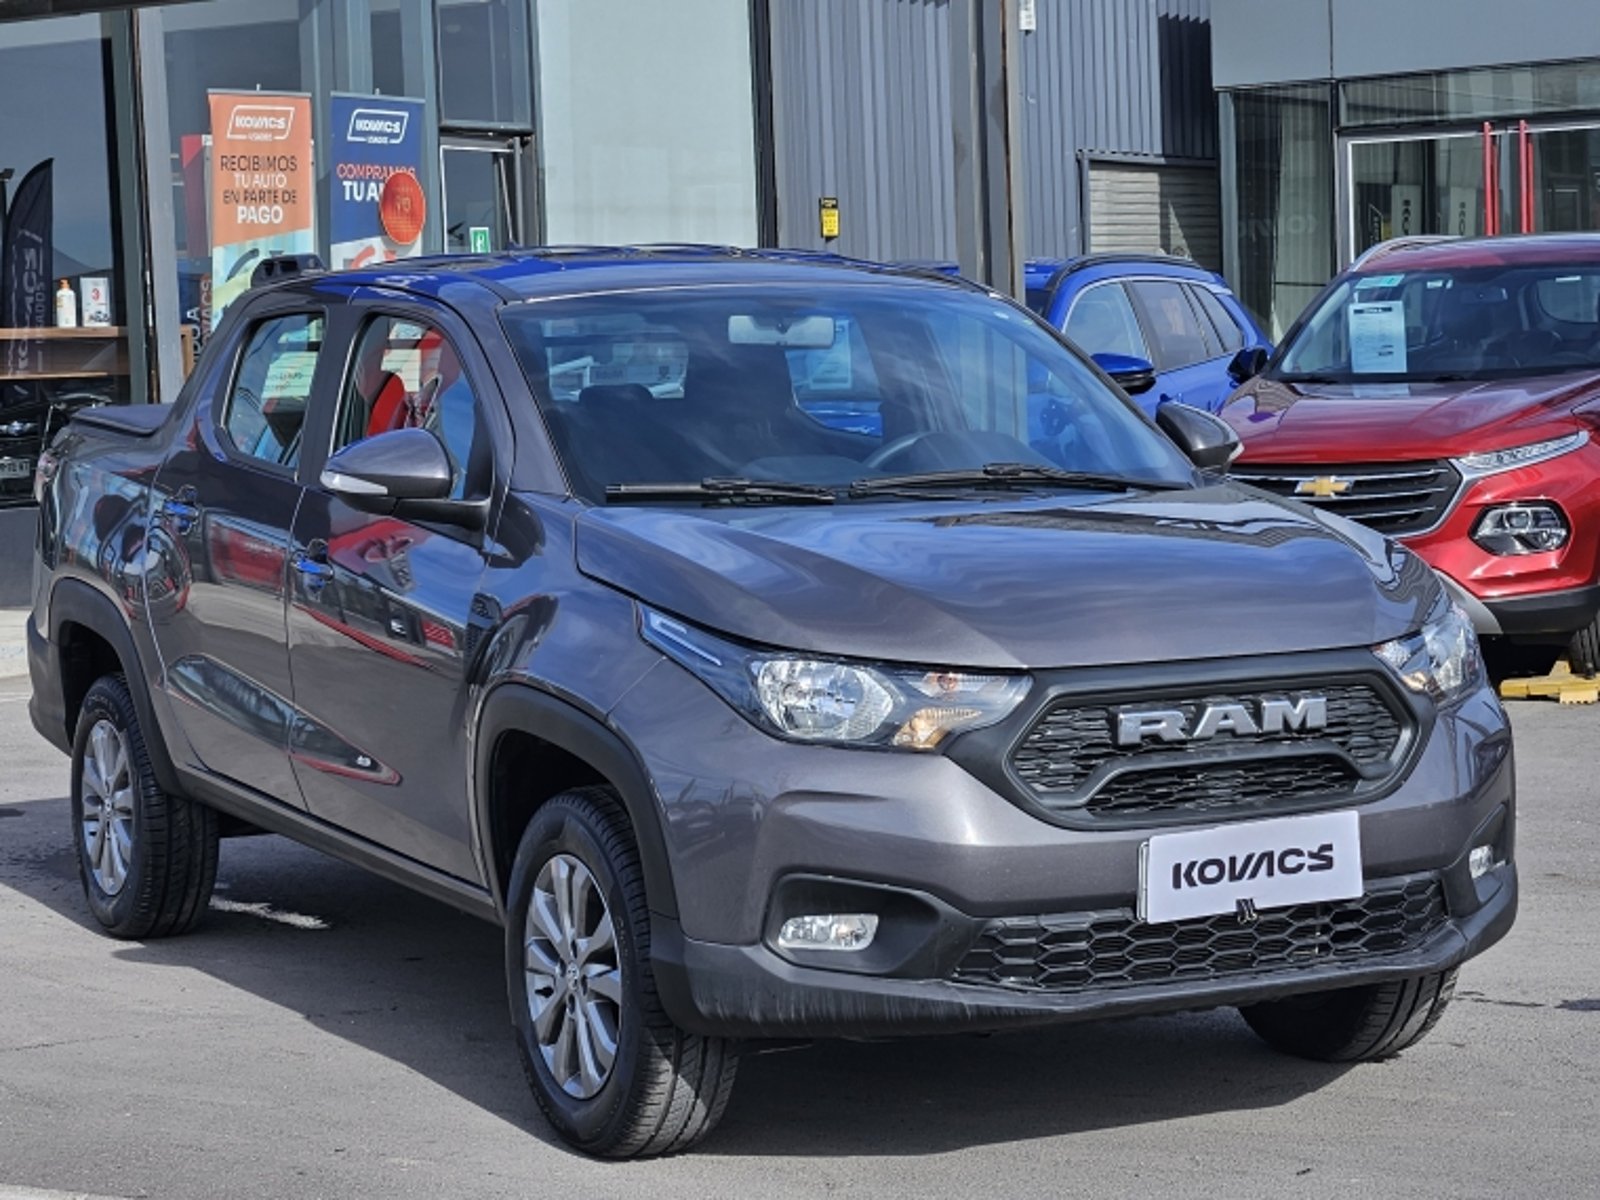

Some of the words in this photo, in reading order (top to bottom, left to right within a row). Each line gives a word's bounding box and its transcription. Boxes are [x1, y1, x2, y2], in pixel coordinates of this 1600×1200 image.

[235, 115, 286, 129] KOVACS
[355, 119, 401, 134] KOVACS
[220, 155, 297, 171] RECIBIMOS
[234, 173, 251, 187] TU
[252, 174, 287, 188] AUTO
[223, 189, 240, 204] EN
[243, 190, 279, 204] PARTE
[281, 190, 297, 204] DE
[342, 180, 365, 201] TU
[236, 205, 284, 224] PAGO
[1117, 696, 1327, 747] RAM
[1172, 842, 1334, 890] KOVACS
